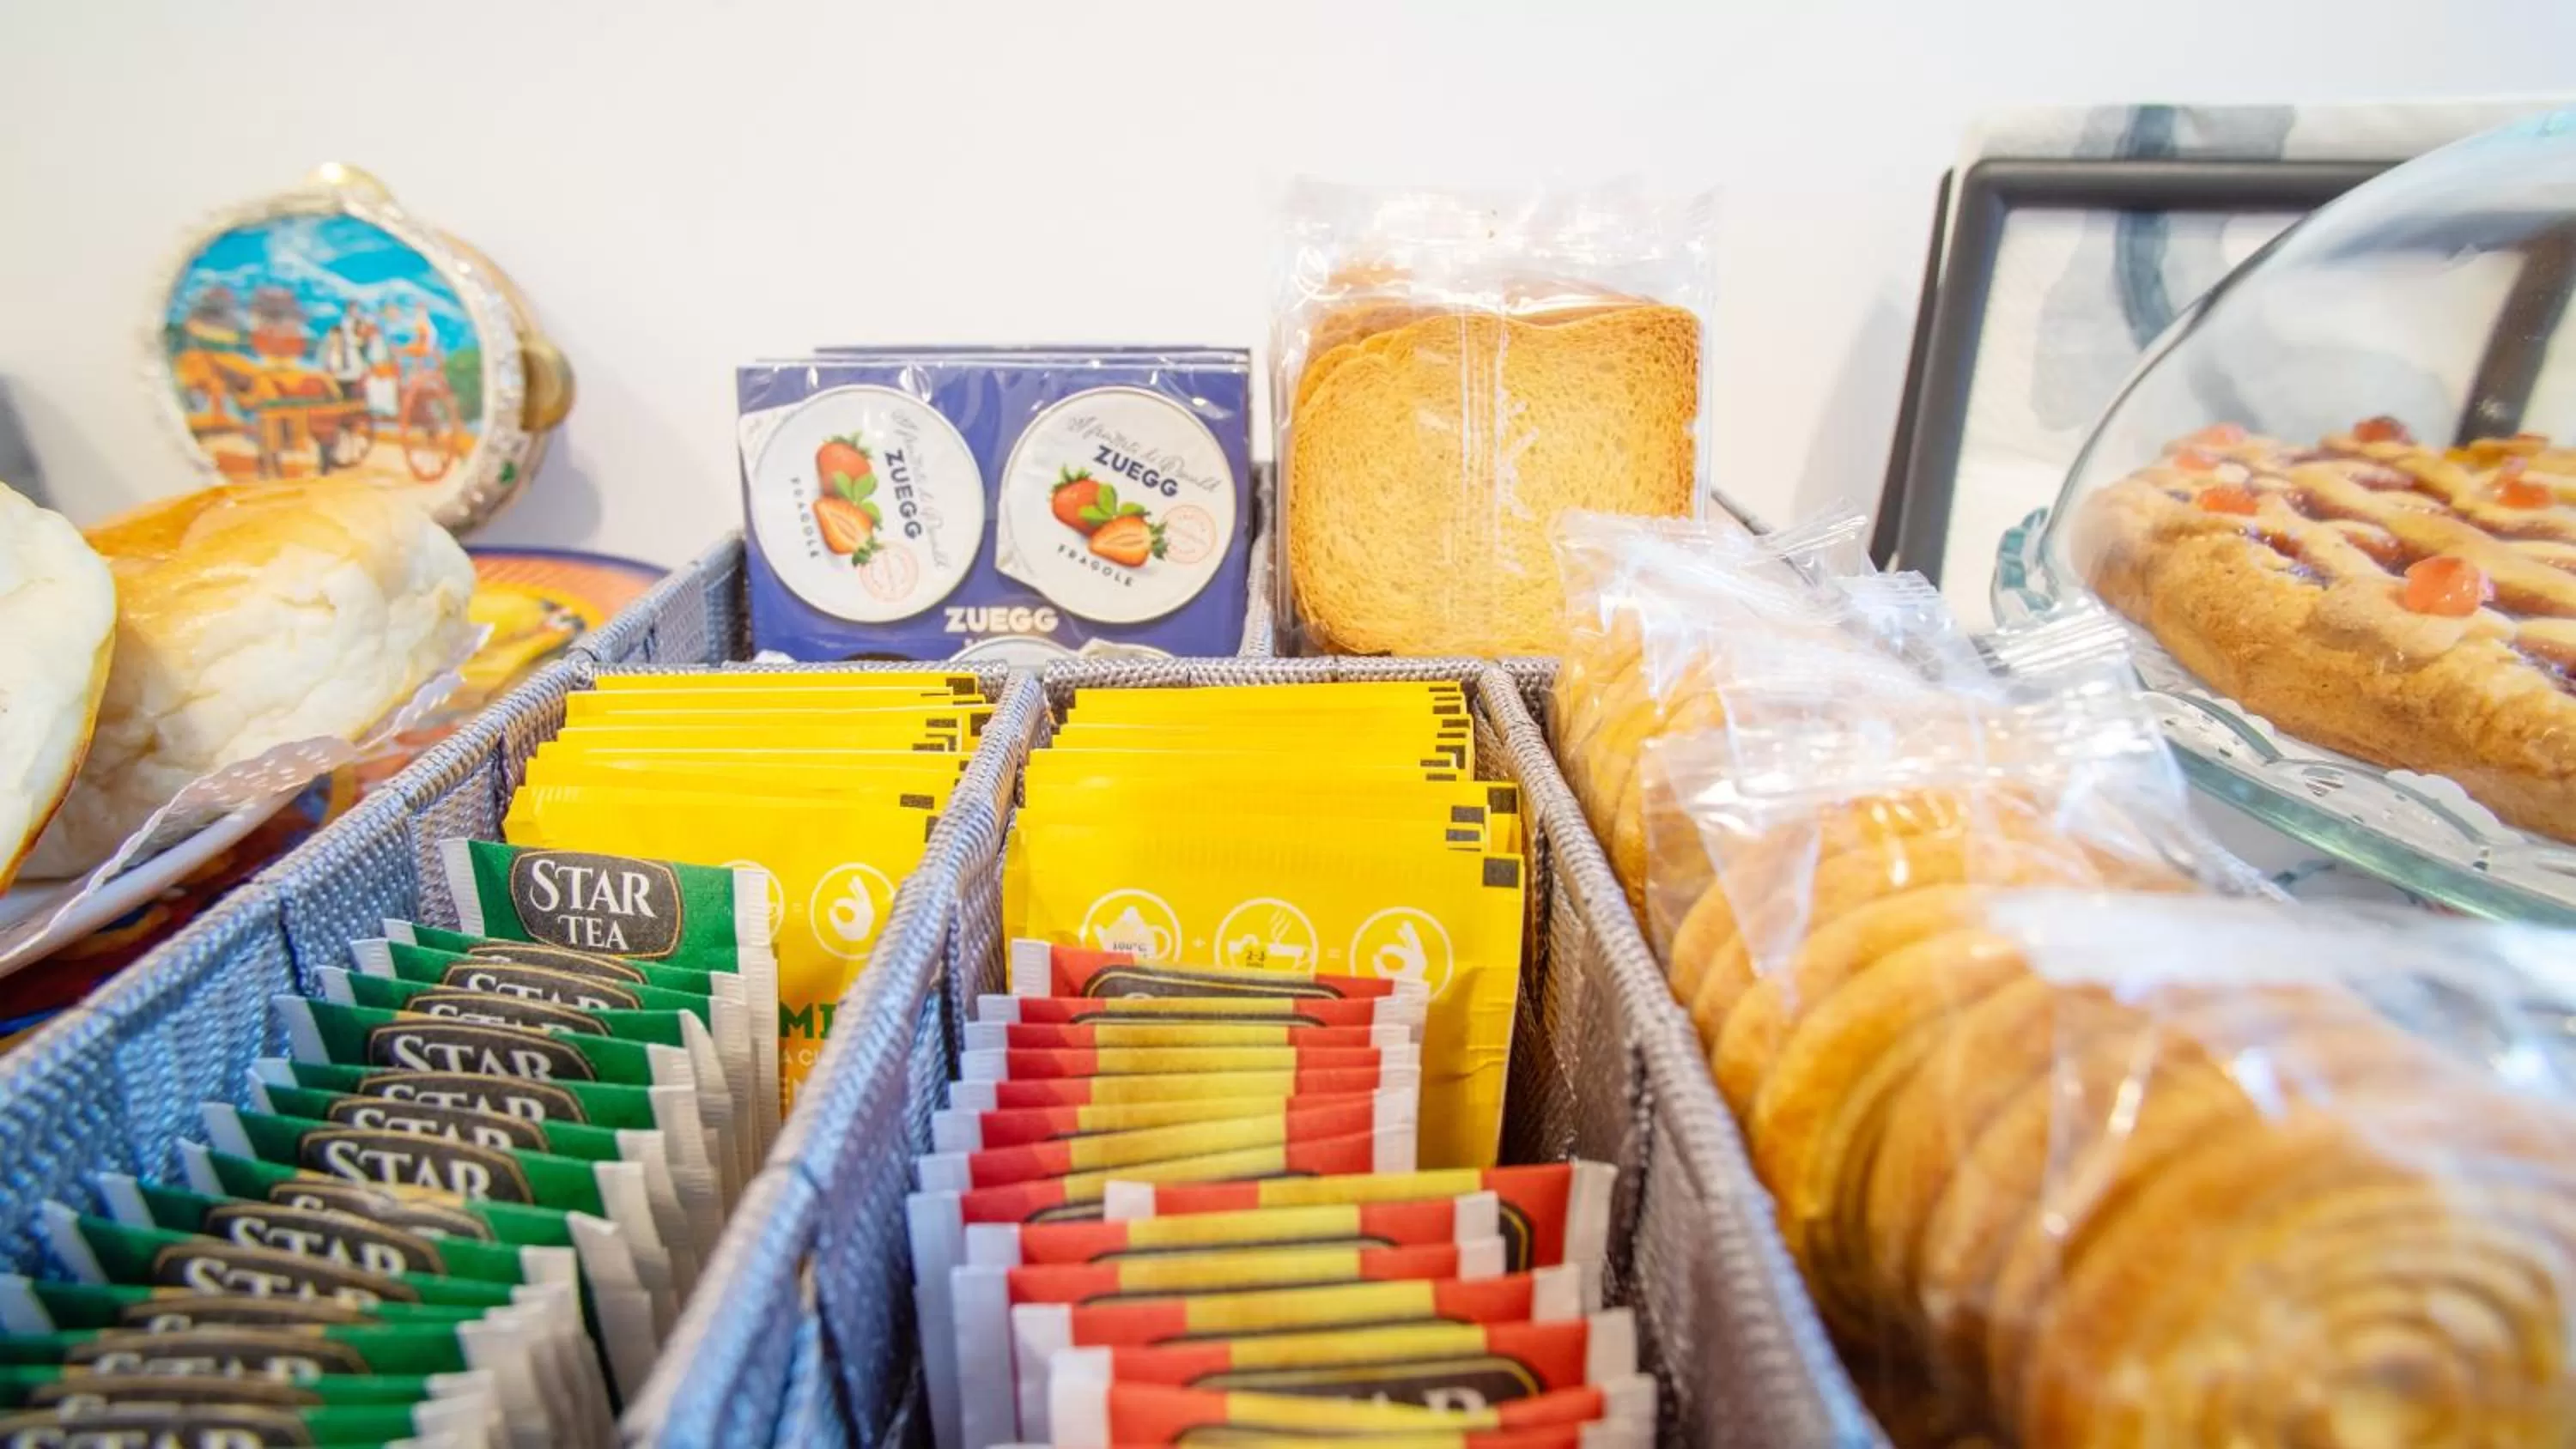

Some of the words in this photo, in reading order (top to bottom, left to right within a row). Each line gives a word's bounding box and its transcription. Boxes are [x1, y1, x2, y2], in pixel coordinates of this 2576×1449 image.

[884, 447, 923, 541] ZUEGG
[1093, 444, 1179, 498] ZUEGG
[789, 476, 820, 559] FRAGOLE
[1057, 543, 1135, 587] FRAGOLE
[945, 606, 1059, 634] ZUEGG
[529, 858, 659, 919] STAR
[556, 913, 630, 952] TEA
[392, 1034, 554, 1082] STAR
[325, 1138, 492, 1201] STAR
